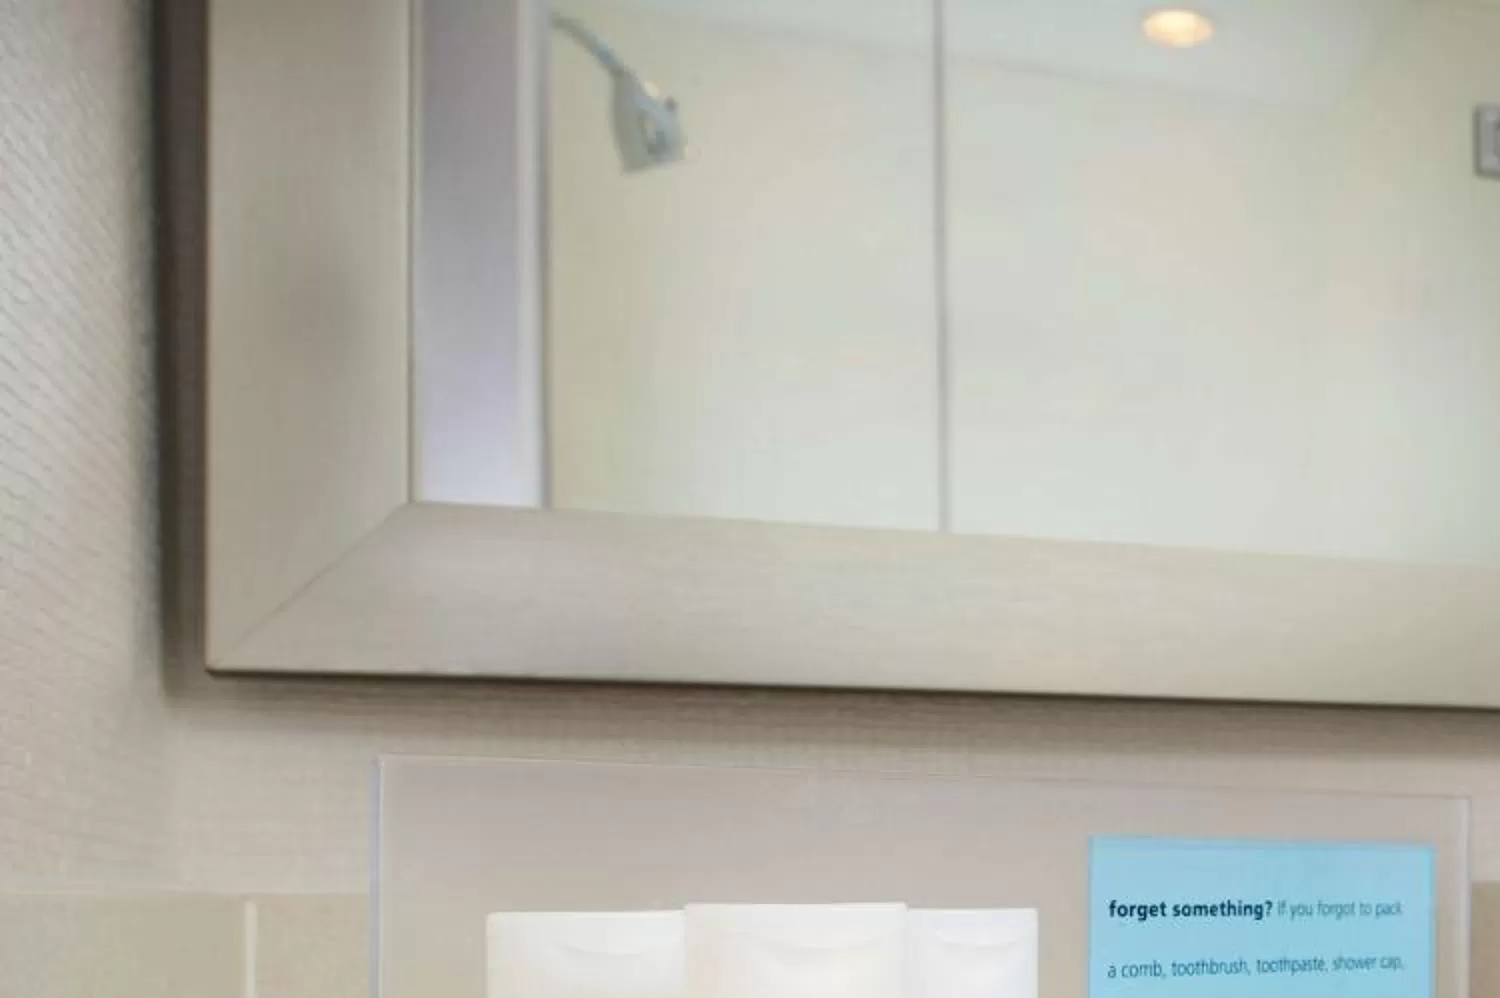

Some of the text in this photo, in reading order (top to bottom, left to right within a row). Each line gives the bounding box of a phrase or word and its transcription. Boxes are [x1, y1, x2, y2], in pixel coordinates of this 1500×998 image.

[1108, 899, 1167, 921] forget
[1171, 899, 1273, 921] something?
[1277, 900, 1287, 917] If
[1289, 903, 1313, 921] you
[1317, 900, 1355, 921] forgot
[1359, 902, 1373, 917] to
[1107, 965, 1117, 979] a
[1120, 959, 1167, 980] comb,
[1171, 956, 1252, 977] toothbrush,
[1256, 956, 1329, 976] toothpaste,
[1332, 953, 1377, 971] shower
